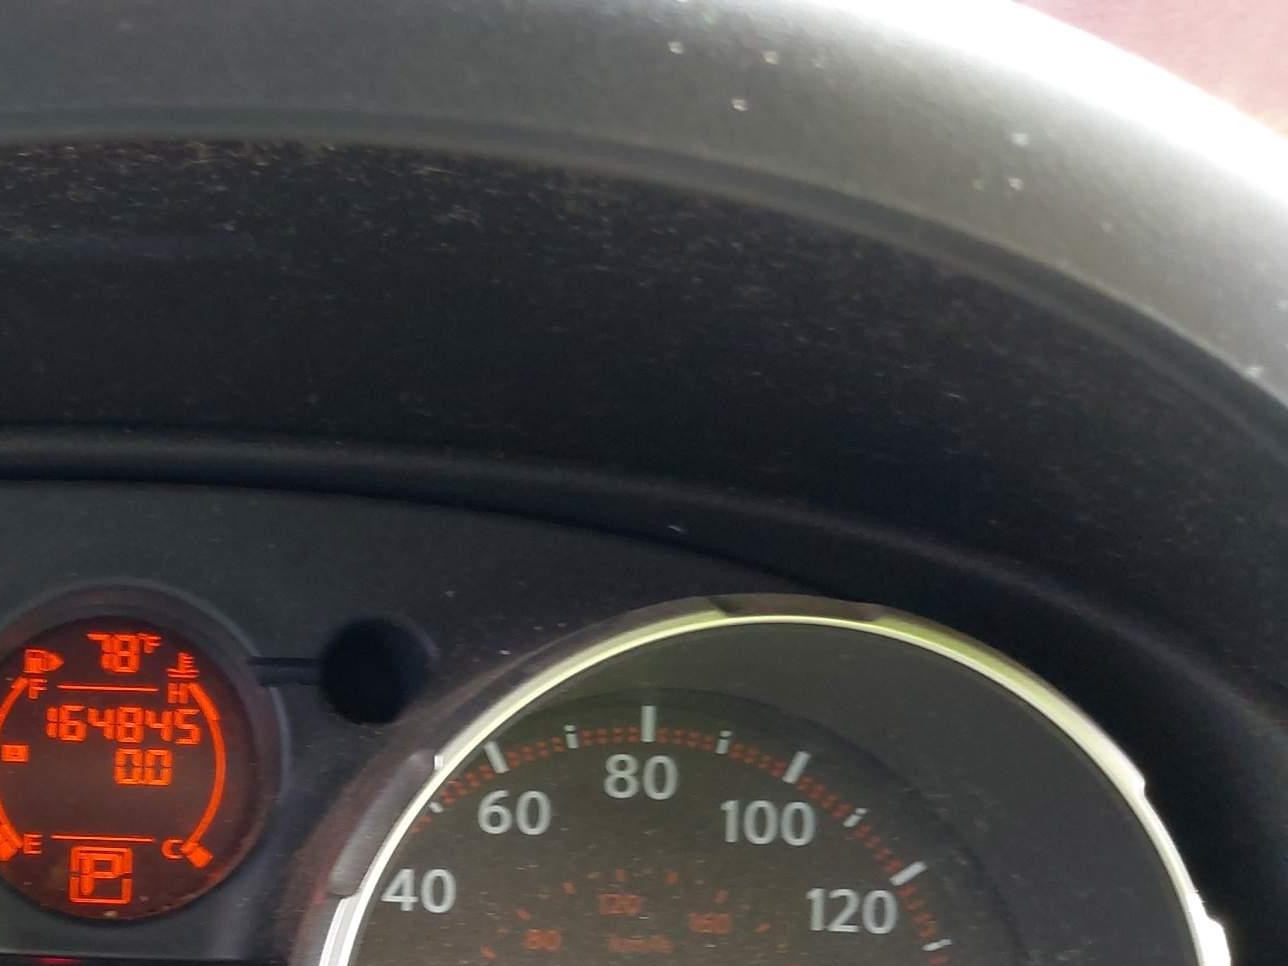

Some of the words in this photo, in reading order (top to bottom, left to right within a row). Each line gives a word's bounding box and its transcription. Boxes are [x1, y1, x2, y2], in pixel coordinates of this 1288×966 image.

[28, 678, 48, 699] F
[45, 704, 202, 744] 164845
[603, 753, 679, 801] 80
[477, 789, 552, 836] 60
[720, 799, 816, 846] 100
[22, 834, 43, 855] E
[161, 838, 185, 860] C
[380, 868, 457, 914] 40
[806, 887, 899, 935] 120
